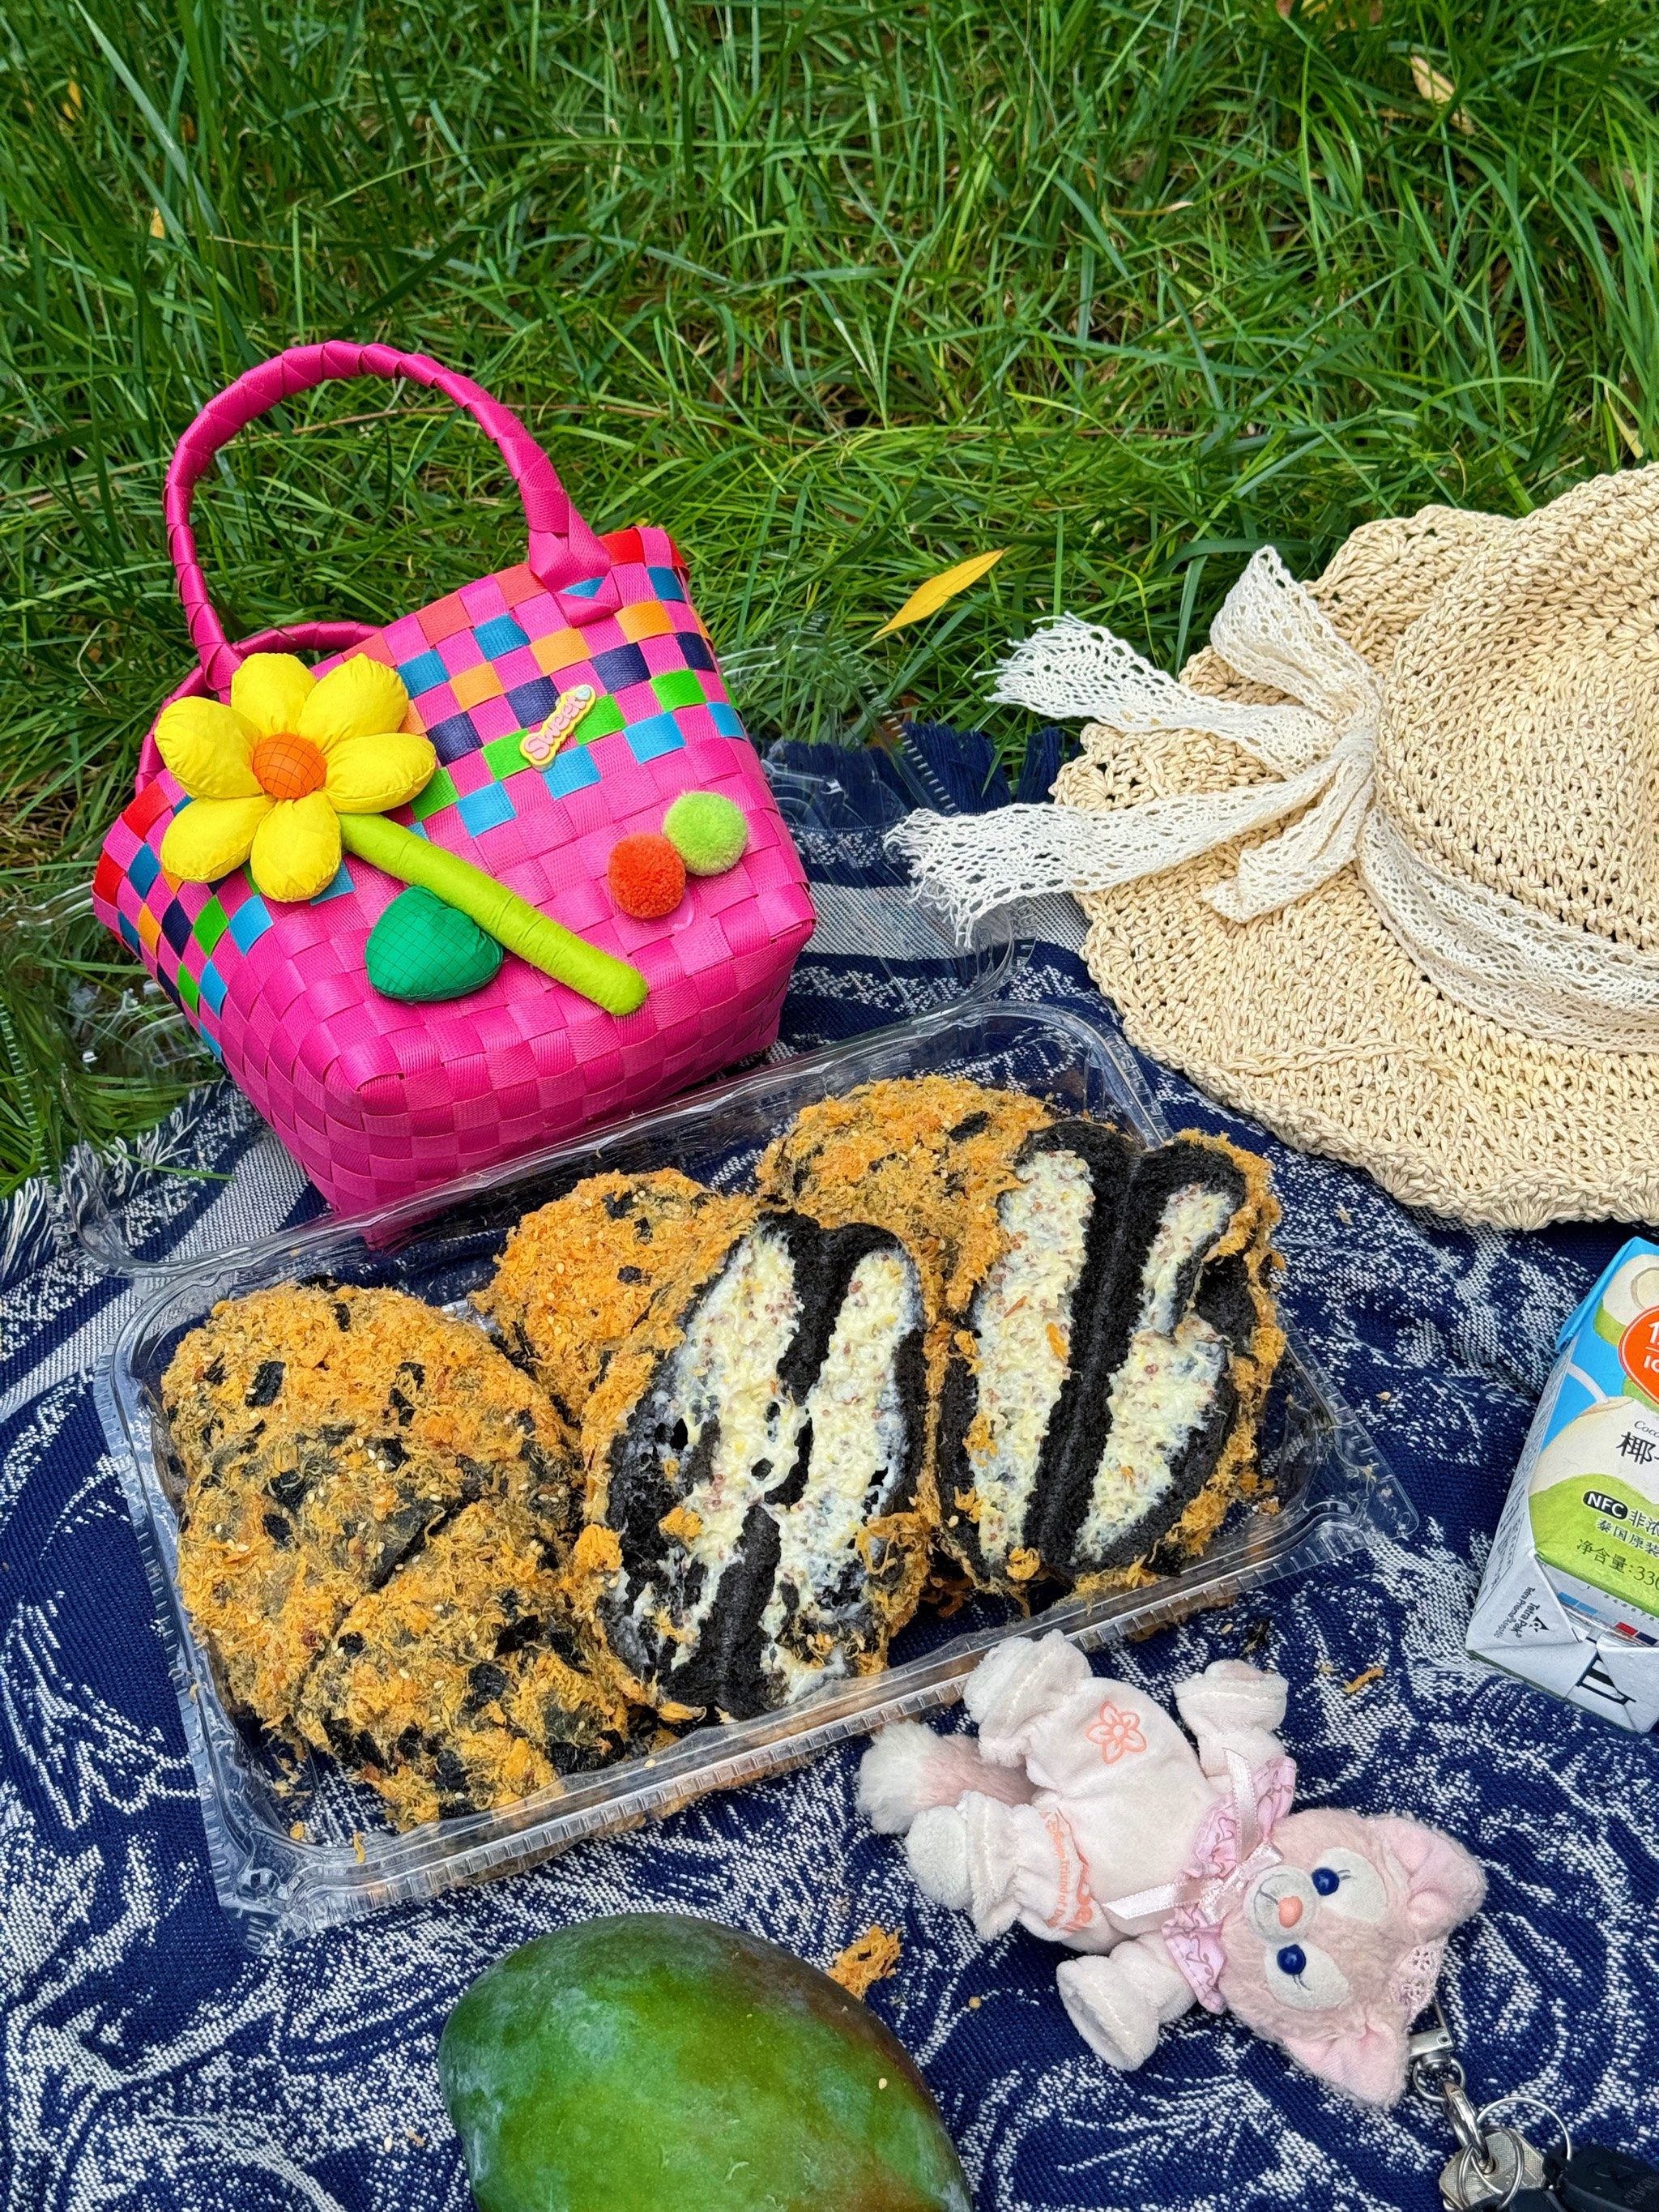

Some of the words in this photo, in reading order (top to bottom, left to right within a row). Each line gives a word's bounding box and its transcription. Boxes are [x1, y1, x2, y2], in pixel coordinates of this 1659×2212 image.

[523, 694, 586, 760] Sweet
[1615, 1431, 1659, 1464] 椰
[1587, 1492, 1623, 1518] NFC
[1520, 1586, 1536, 1599] Tetra
[1520, 1603, 1541, 1621] Tetra
